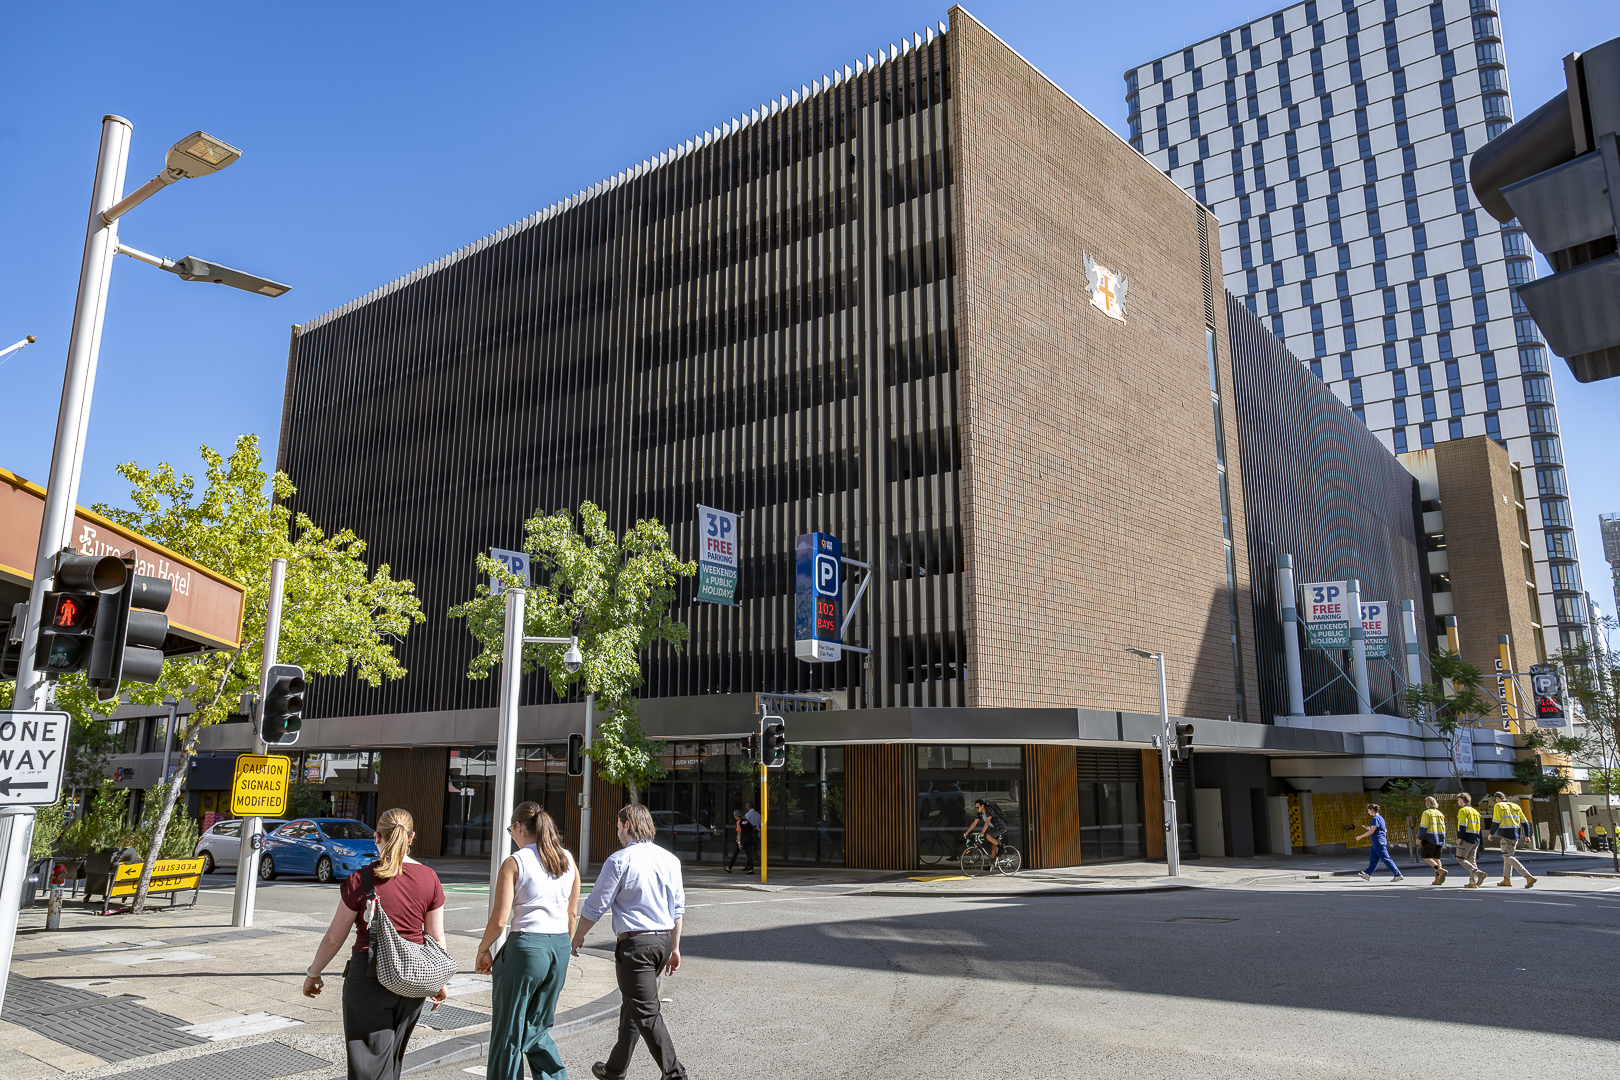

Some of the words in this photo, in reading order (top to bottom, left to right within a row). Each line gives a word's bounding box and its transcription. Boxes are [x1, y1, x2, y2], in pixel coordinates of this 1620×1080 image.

[707, 513, 731, 538] 3P
[707, 538, 732, 555] FREE
[79, 525, 155, 577] Euroan
[157, 559, 190, 596] Hotel
[707, 552, 732, 564] PARKING
[702, 564, 737, 579] WEEKENDS
[821, 562, 833, 586] P
[710, 576, 733, 588] PUBLIC
[701, 585, 734, 599] HOLIDAYS
[1312, 586, 1340, 603] 3P
[817, 601, 834, 616] 102
[1313, 604, 1341, 614] FREE
[817, 618, 835, 631] BAYS
[1308, 623, 1348, 631] WEEKENDS
[1361, 621, 1381, 630] REE
[1311, 637, 1347, 645] HOLIDAYS
[1540, 678, 1552, 691] P
[0, 721, 57, 741] ONE
[243, 763, 283, 775] CAUTION
[241, 780, 281, 791] SIGNALS
[236, 796, 282, 807] MODIFIED
[152, 863, 197, 872] PEDESTRIA
[132, 876, 182, 890] COSED
